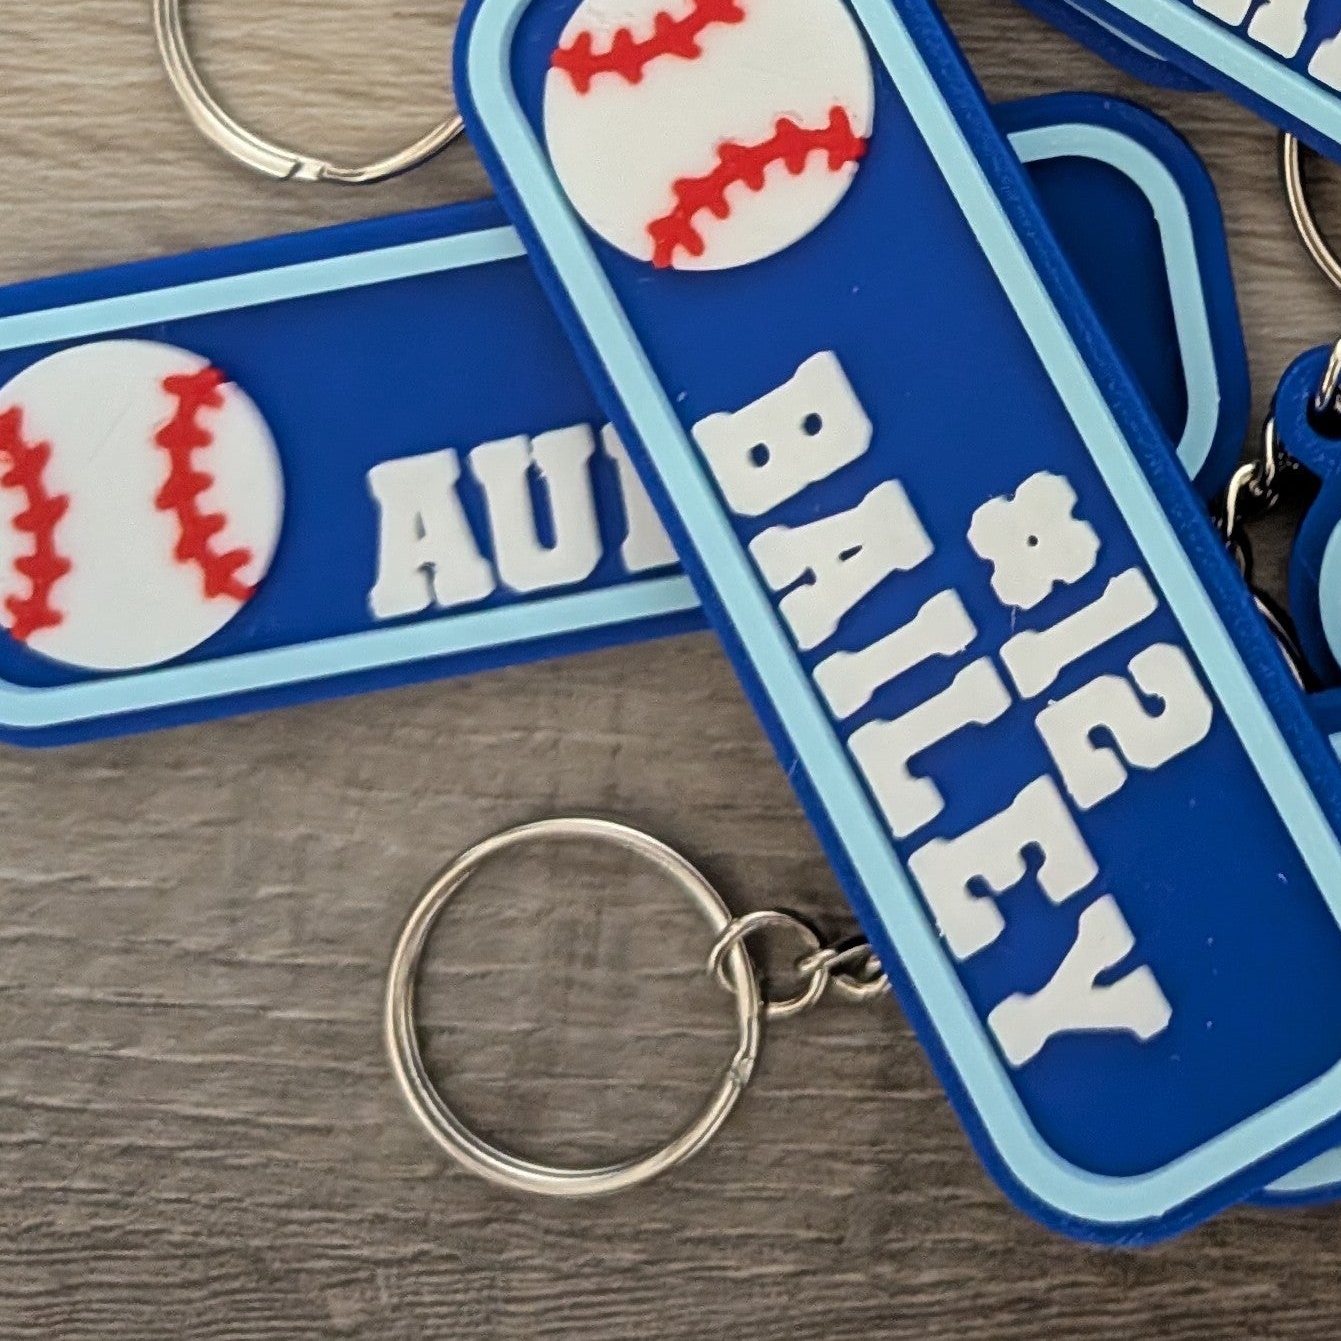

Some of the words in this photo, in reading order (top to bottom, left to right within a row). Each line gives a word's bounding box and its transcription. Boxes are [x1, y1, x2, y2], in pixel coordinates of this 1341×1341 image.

[366, 422, 681, 620] AU
[967, 472, 1213, 811] #12
[692, 351, 1171, 1067] BAILEY
